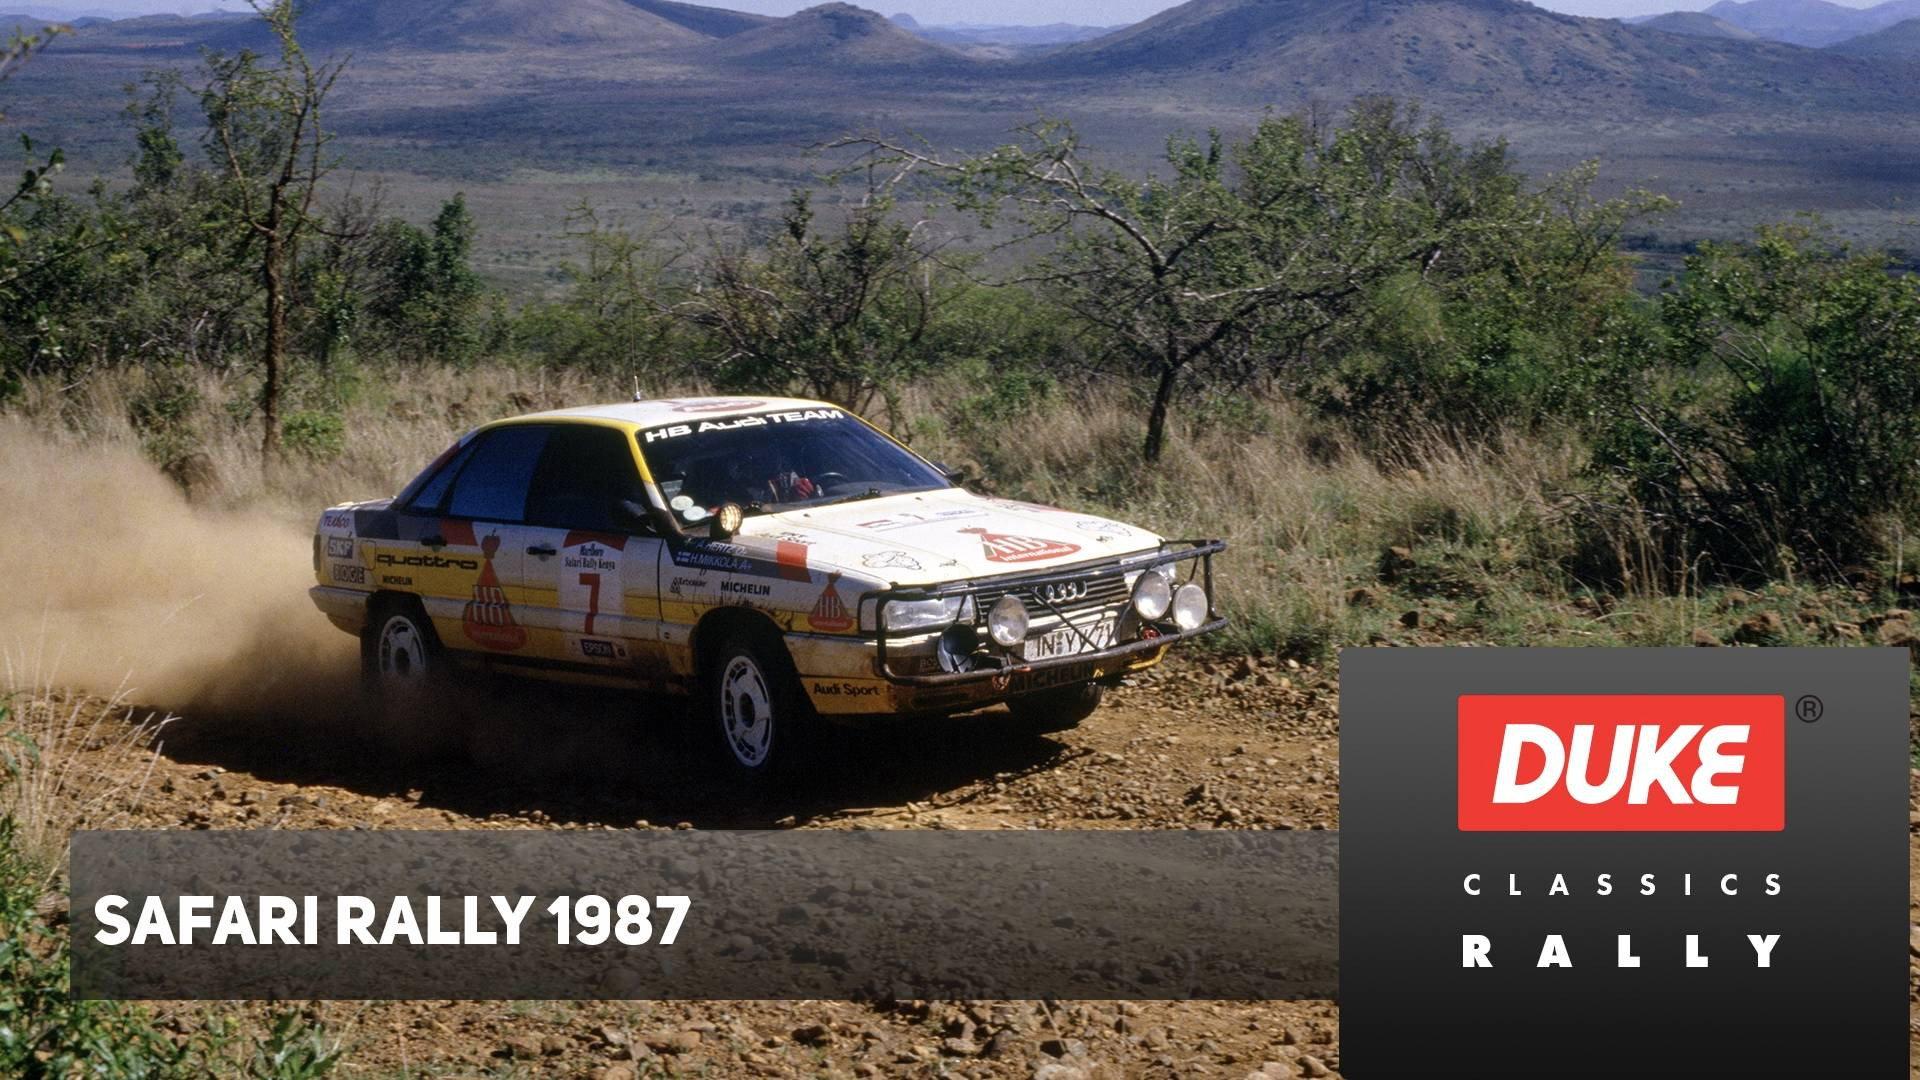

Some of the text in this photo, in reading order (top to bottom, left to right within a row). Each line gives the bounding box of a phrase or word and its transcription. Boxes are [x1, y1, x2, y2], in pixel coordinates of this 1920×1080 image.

[646, 424, 692, 442] HB
[767, 409, 844, 424] TEAM
[376, 554, 478, 570] quattro
[565, 557, 616, 572] Safari Rally Kenya
[721, 581, 770, 596] MICHELIN
[579, 573, 600, 635] 7
[584, 641, 612, 657] EPSON
[814, 683, 880, 698] Audi Sport
